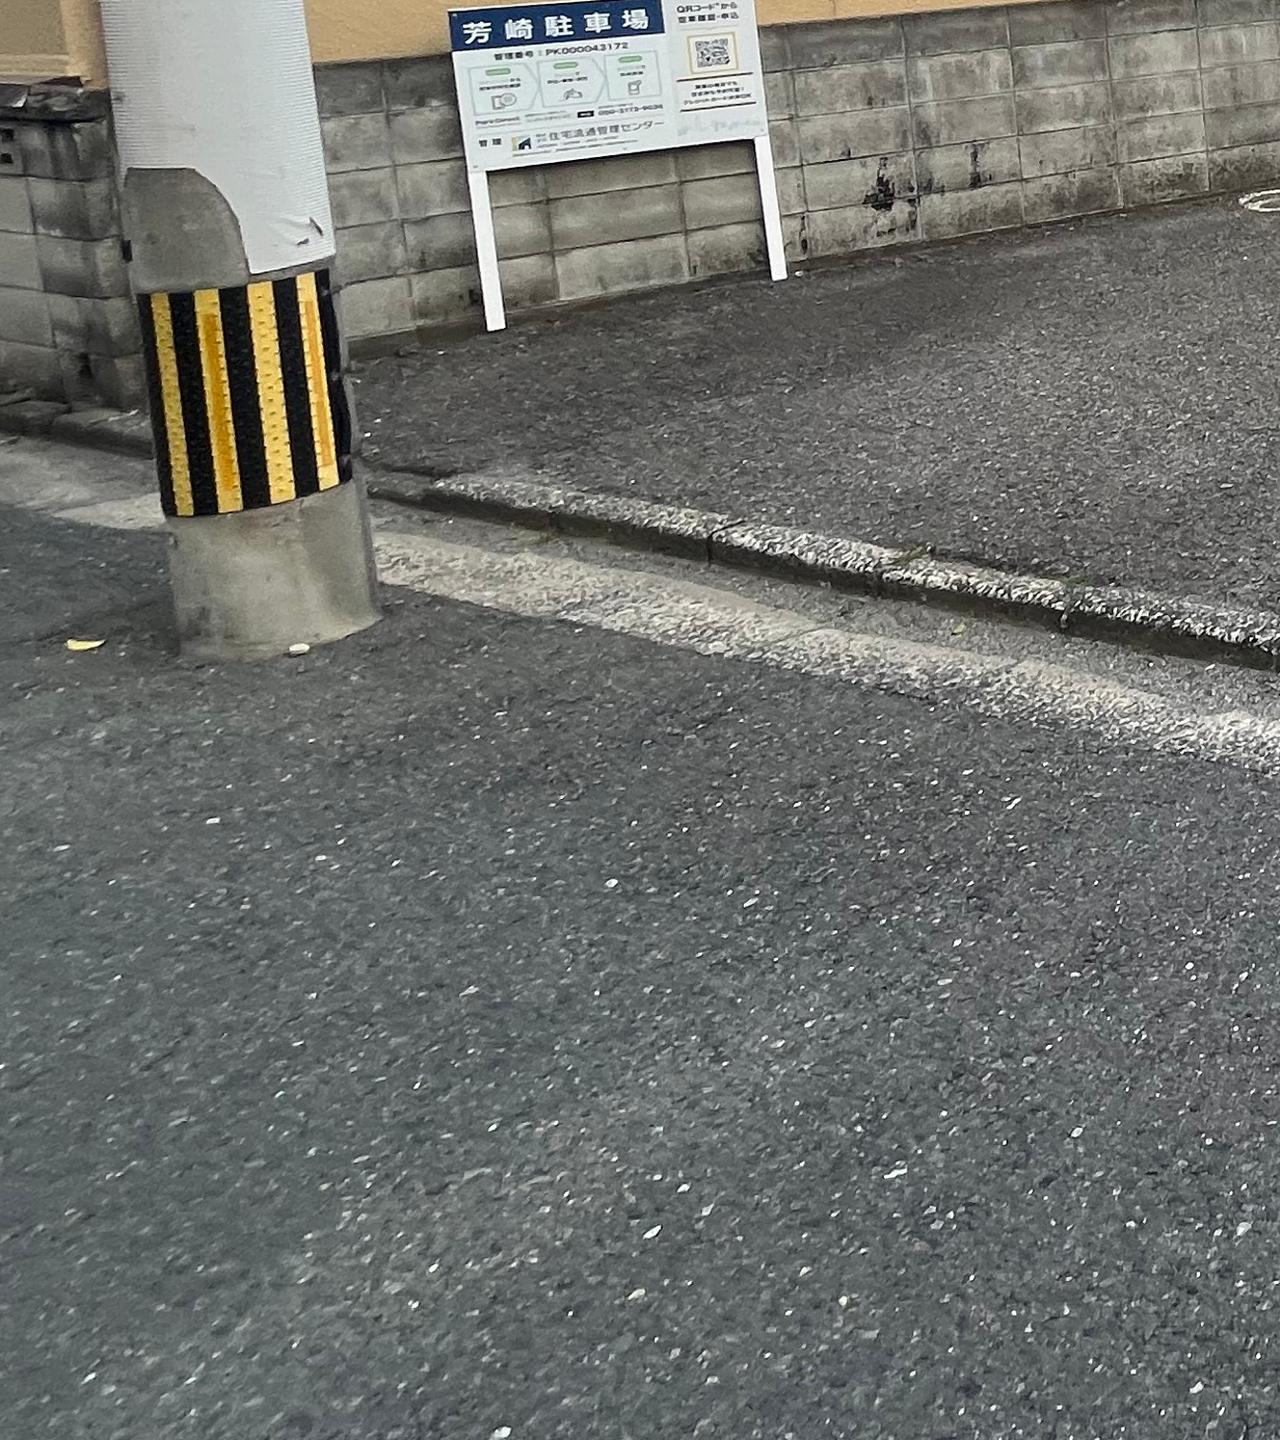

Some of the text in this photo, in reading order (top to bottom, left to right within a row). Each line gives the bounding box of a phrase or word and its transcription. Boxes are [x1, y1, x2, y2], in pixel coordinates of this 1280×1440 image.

[462, 9, 649, 45] 芳崎駐車場
